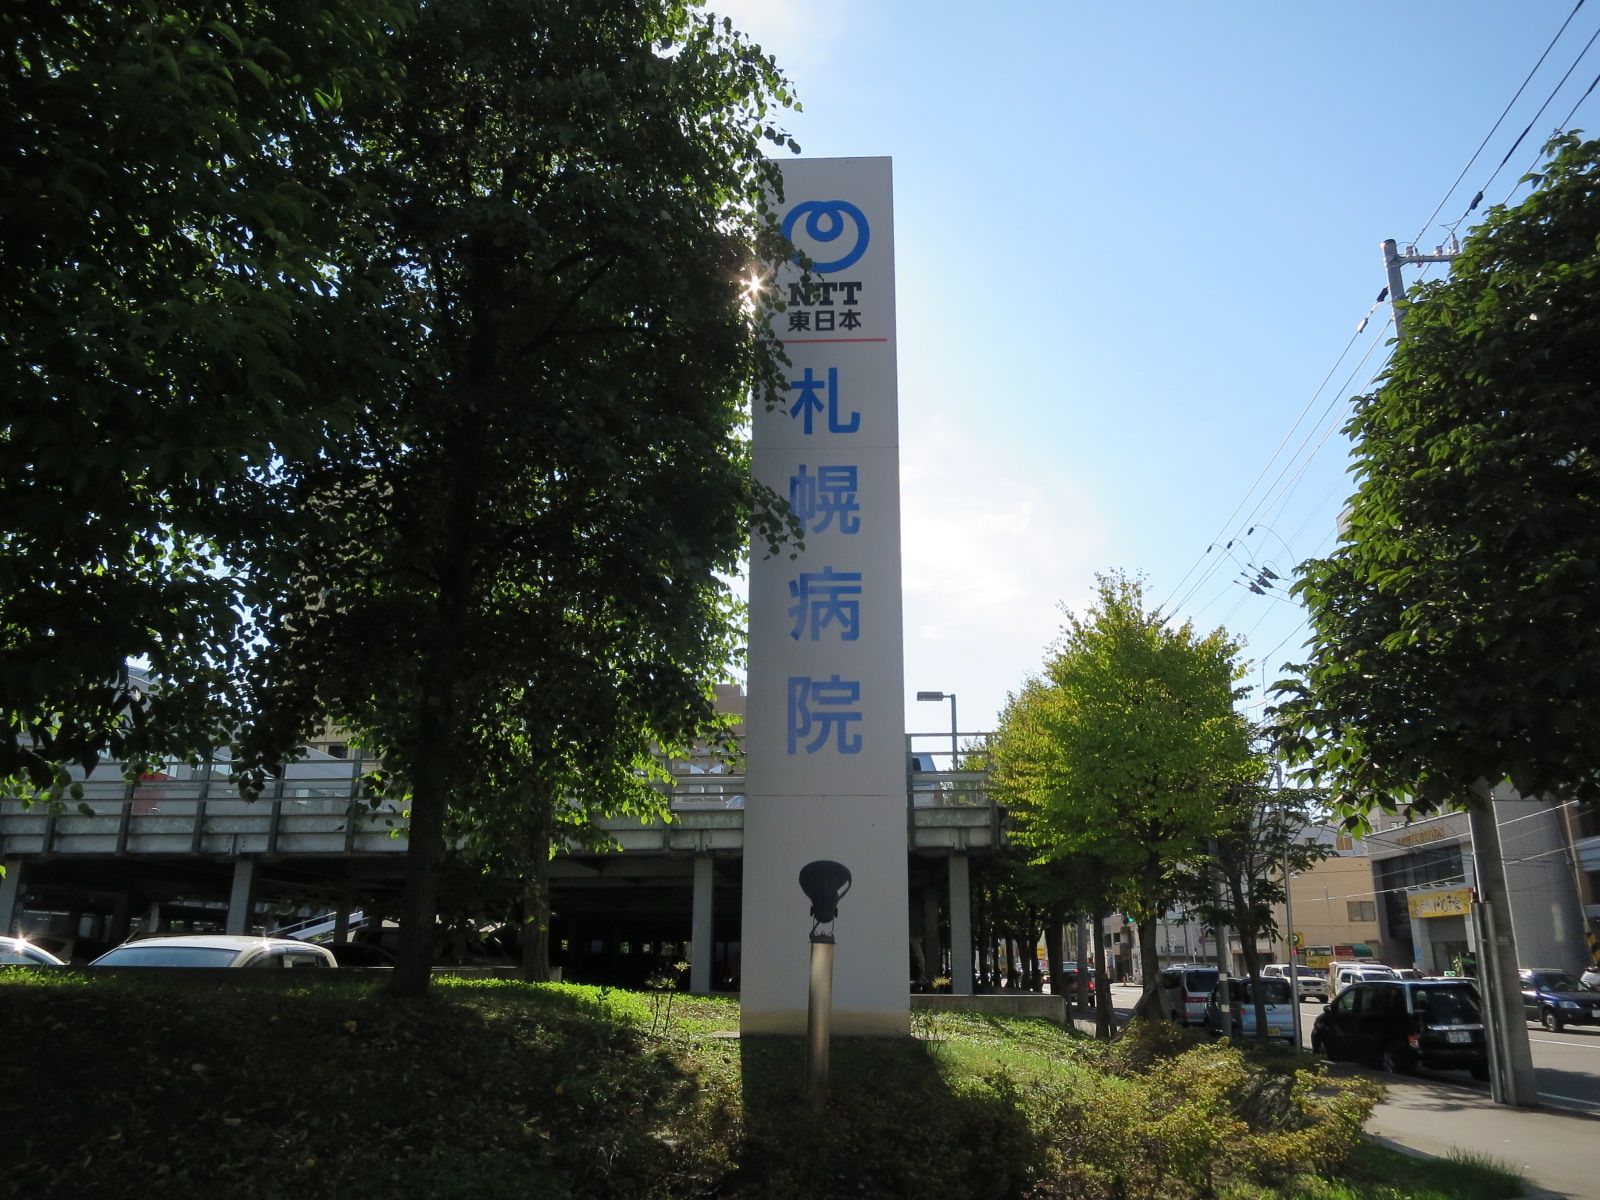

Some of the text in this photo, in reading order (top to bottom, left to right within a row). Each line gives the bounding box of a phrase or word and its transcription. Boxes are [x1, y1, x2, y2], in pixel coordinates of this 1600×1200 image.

[788, 282, 862, 306] NTT
[788, 309, 862, 332] 東日本
[787, 367, 862, 755] 札幌病院
